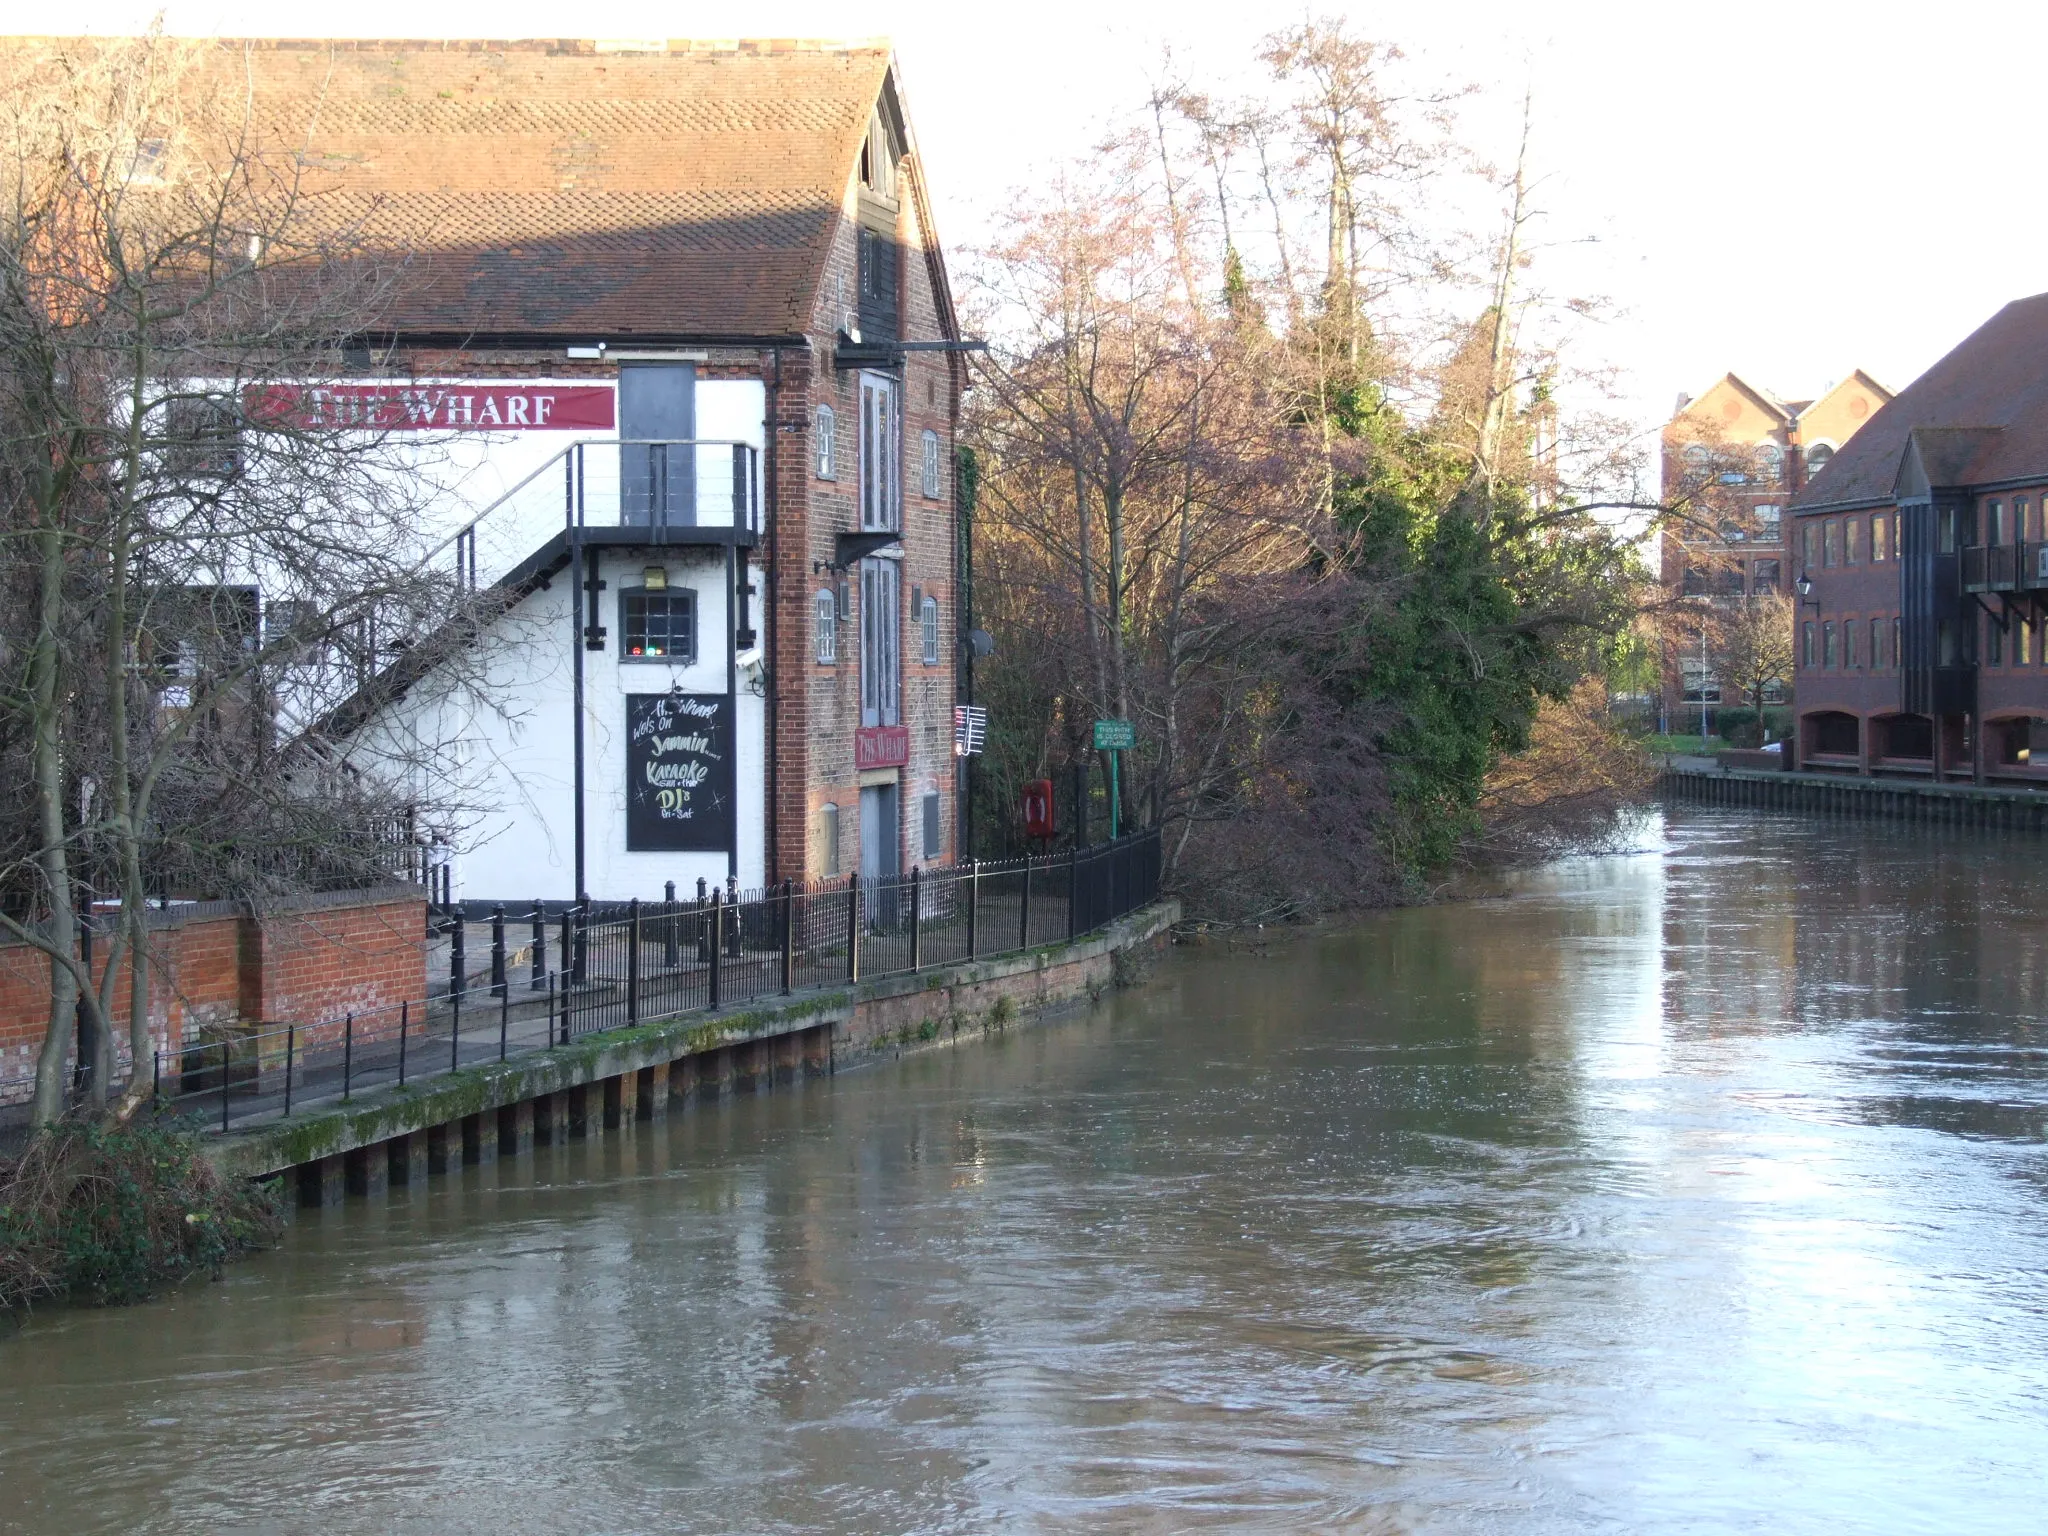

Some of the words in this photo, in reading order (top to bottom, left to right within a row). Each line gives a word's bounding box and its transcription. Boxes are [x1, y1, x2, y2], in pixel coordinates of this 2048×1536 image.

[308, 390, 389, 425] THE
[400, 390, 555, 425] WHARF
[858, 734, 876, 763] THE
